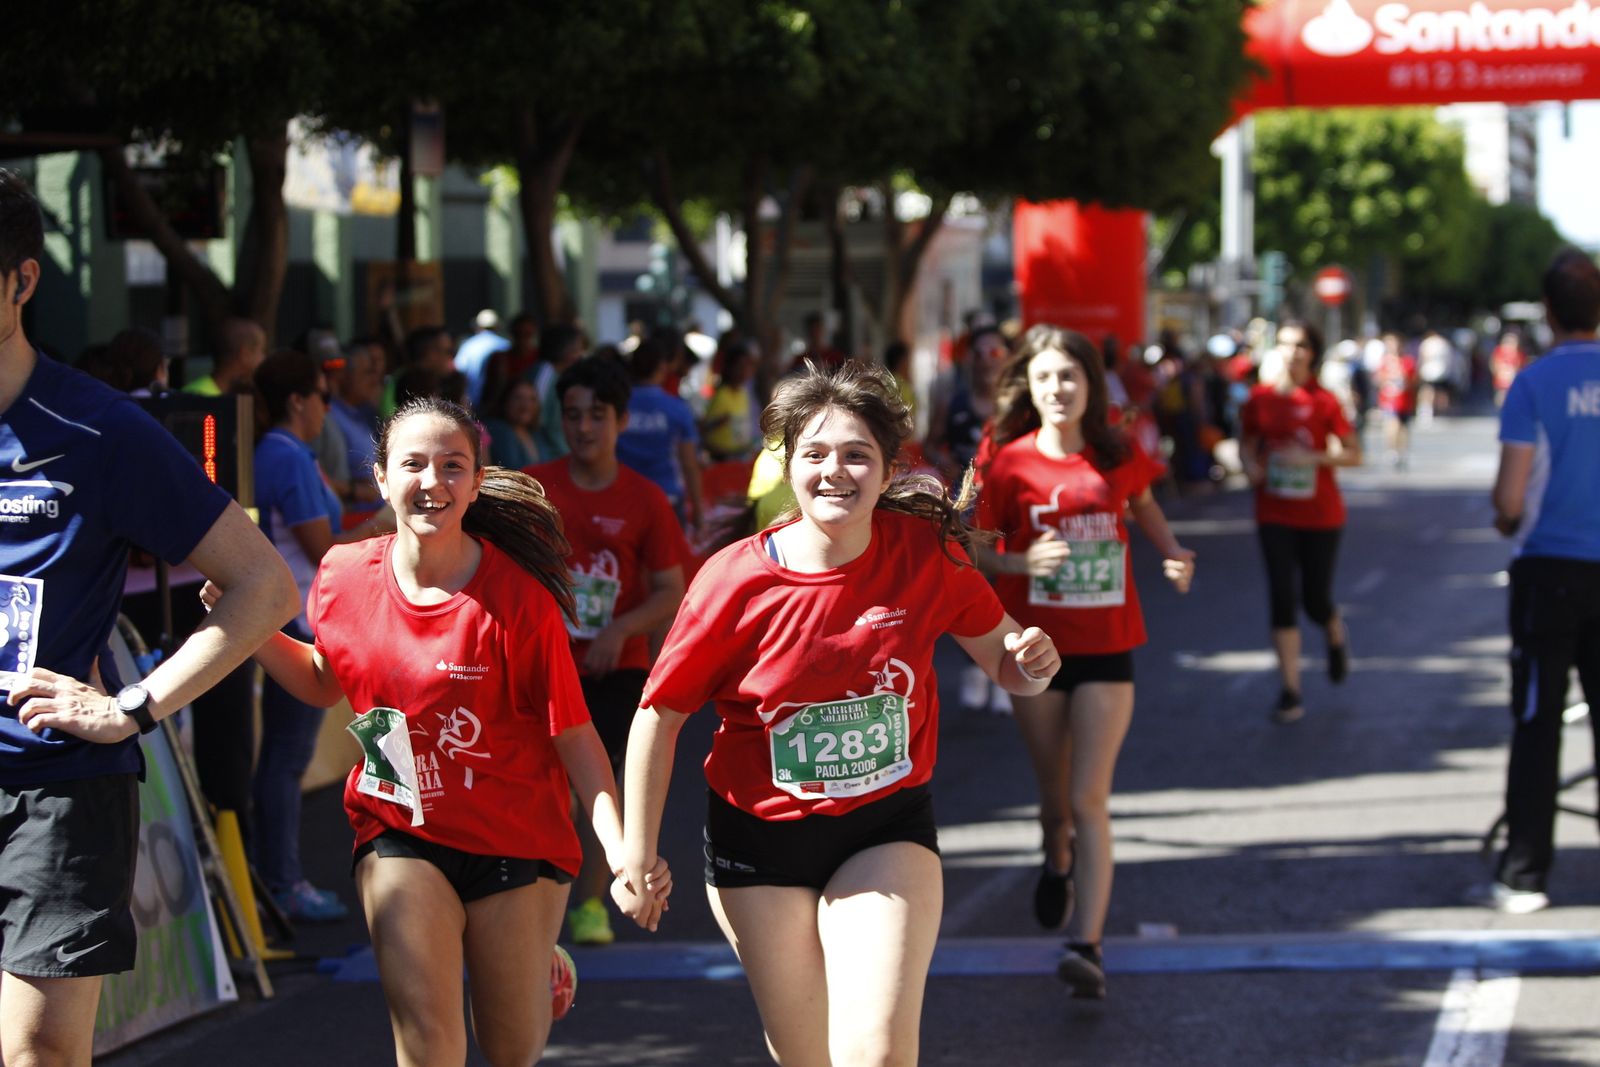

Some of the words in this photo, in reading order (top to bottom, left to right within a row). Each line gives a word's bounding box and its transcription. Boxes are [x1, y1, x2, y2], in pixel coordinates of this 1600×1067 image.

[867, 608, 907, 622] Santander
[448, 662, 489, 672] Santander
[788, 723, 889, 763] 1283
[815, 762, 850, 778] PAOLA
[851, 758, 877, 775] 2006
